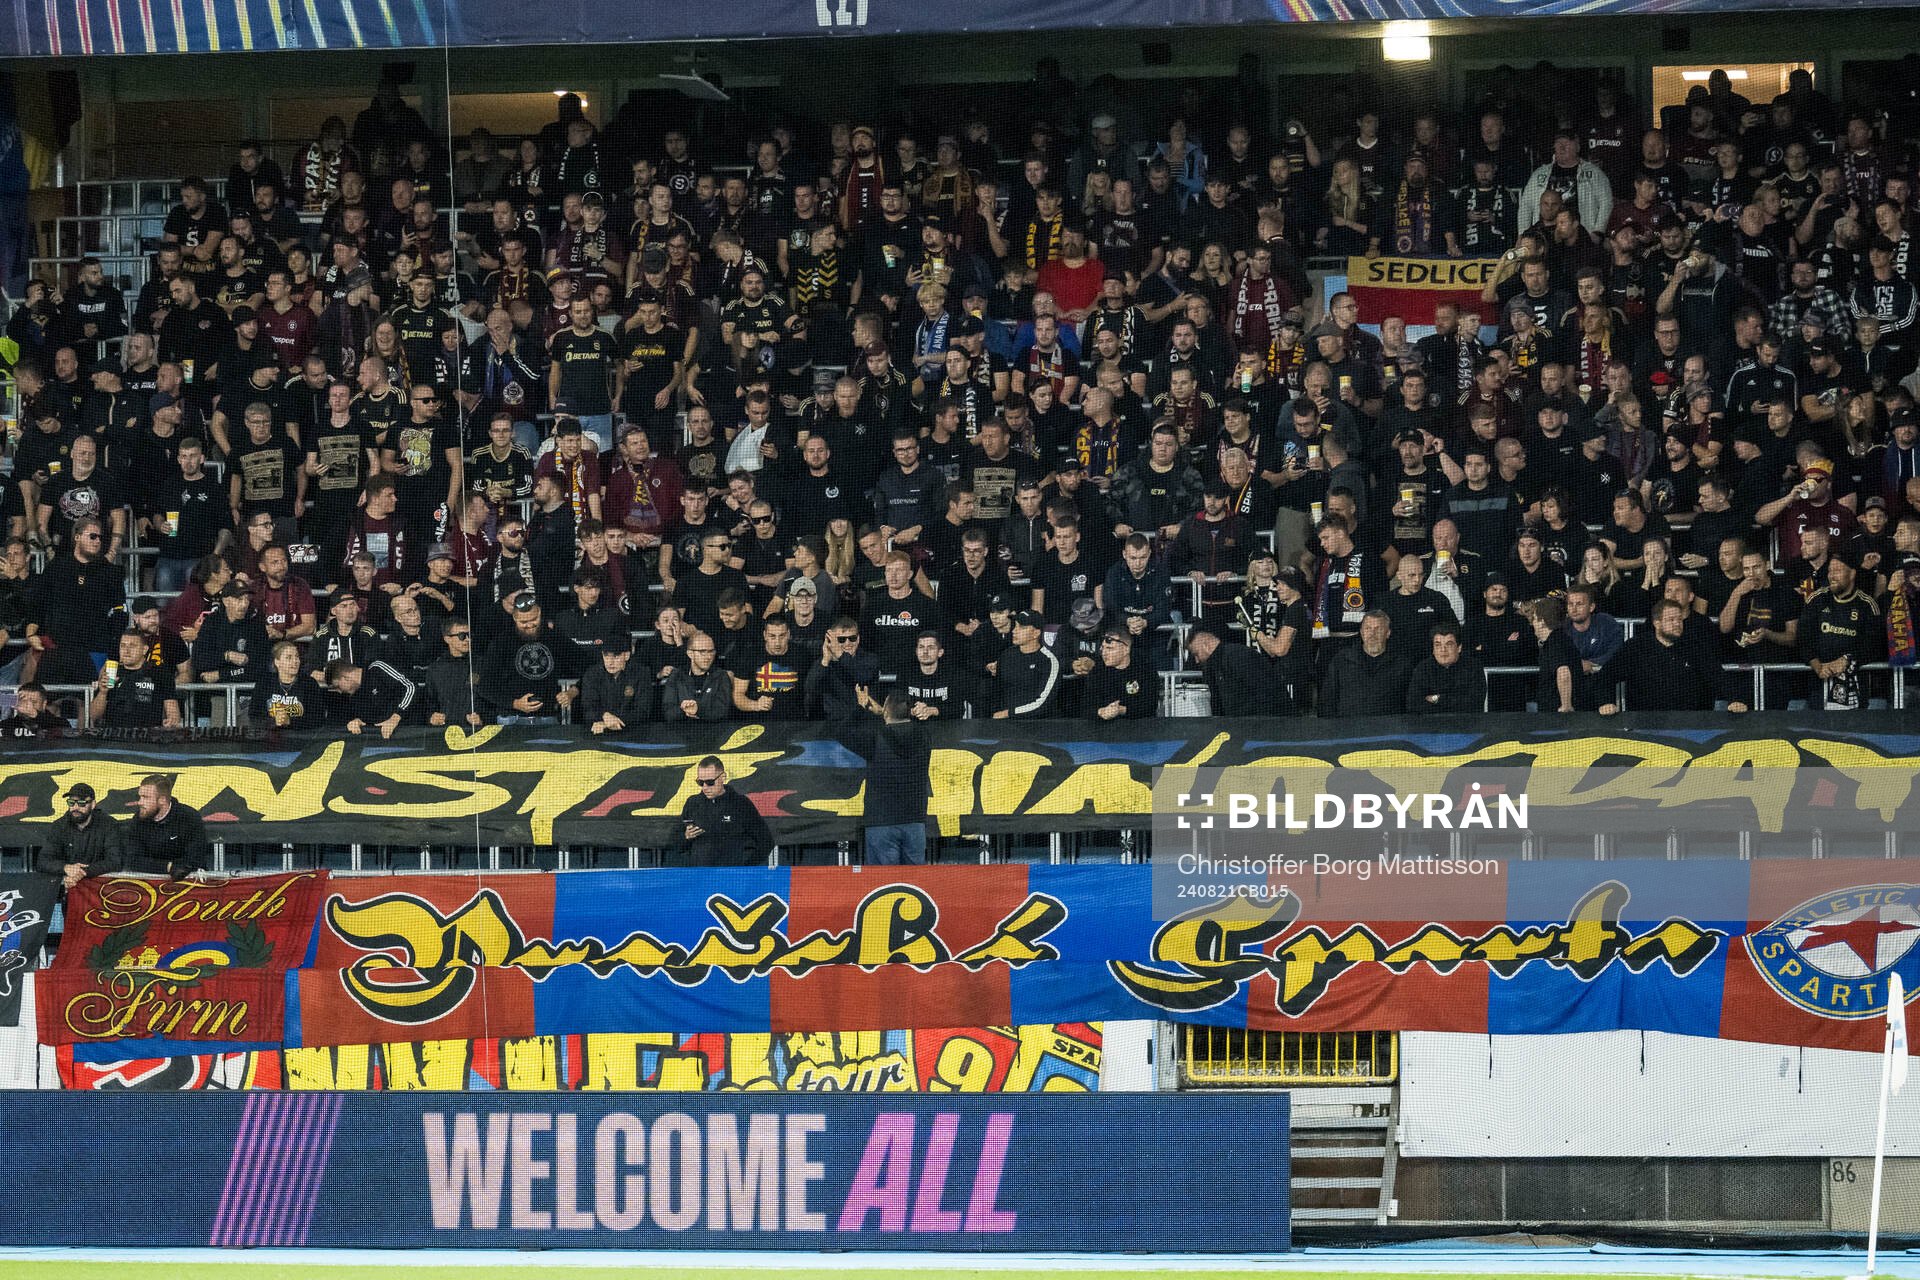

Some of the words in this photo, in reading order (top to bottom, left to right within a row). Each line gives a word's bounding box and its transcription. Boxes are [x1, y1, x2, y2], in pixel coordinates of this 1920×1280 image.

[1368, 260, 1495, 285] SEDLICE
[874, 614, 920, 627] ellesse
[271, 693, 300, 705] SPARTA
[85, 873, 317, 928] Youth
[65, 966, 249, 1038] Firm
[422, 1112, 826, 1232] WELCOME
[836, 1113, 1017, 1232] ALL
[1833, 1160, 1856, 1184] 86
